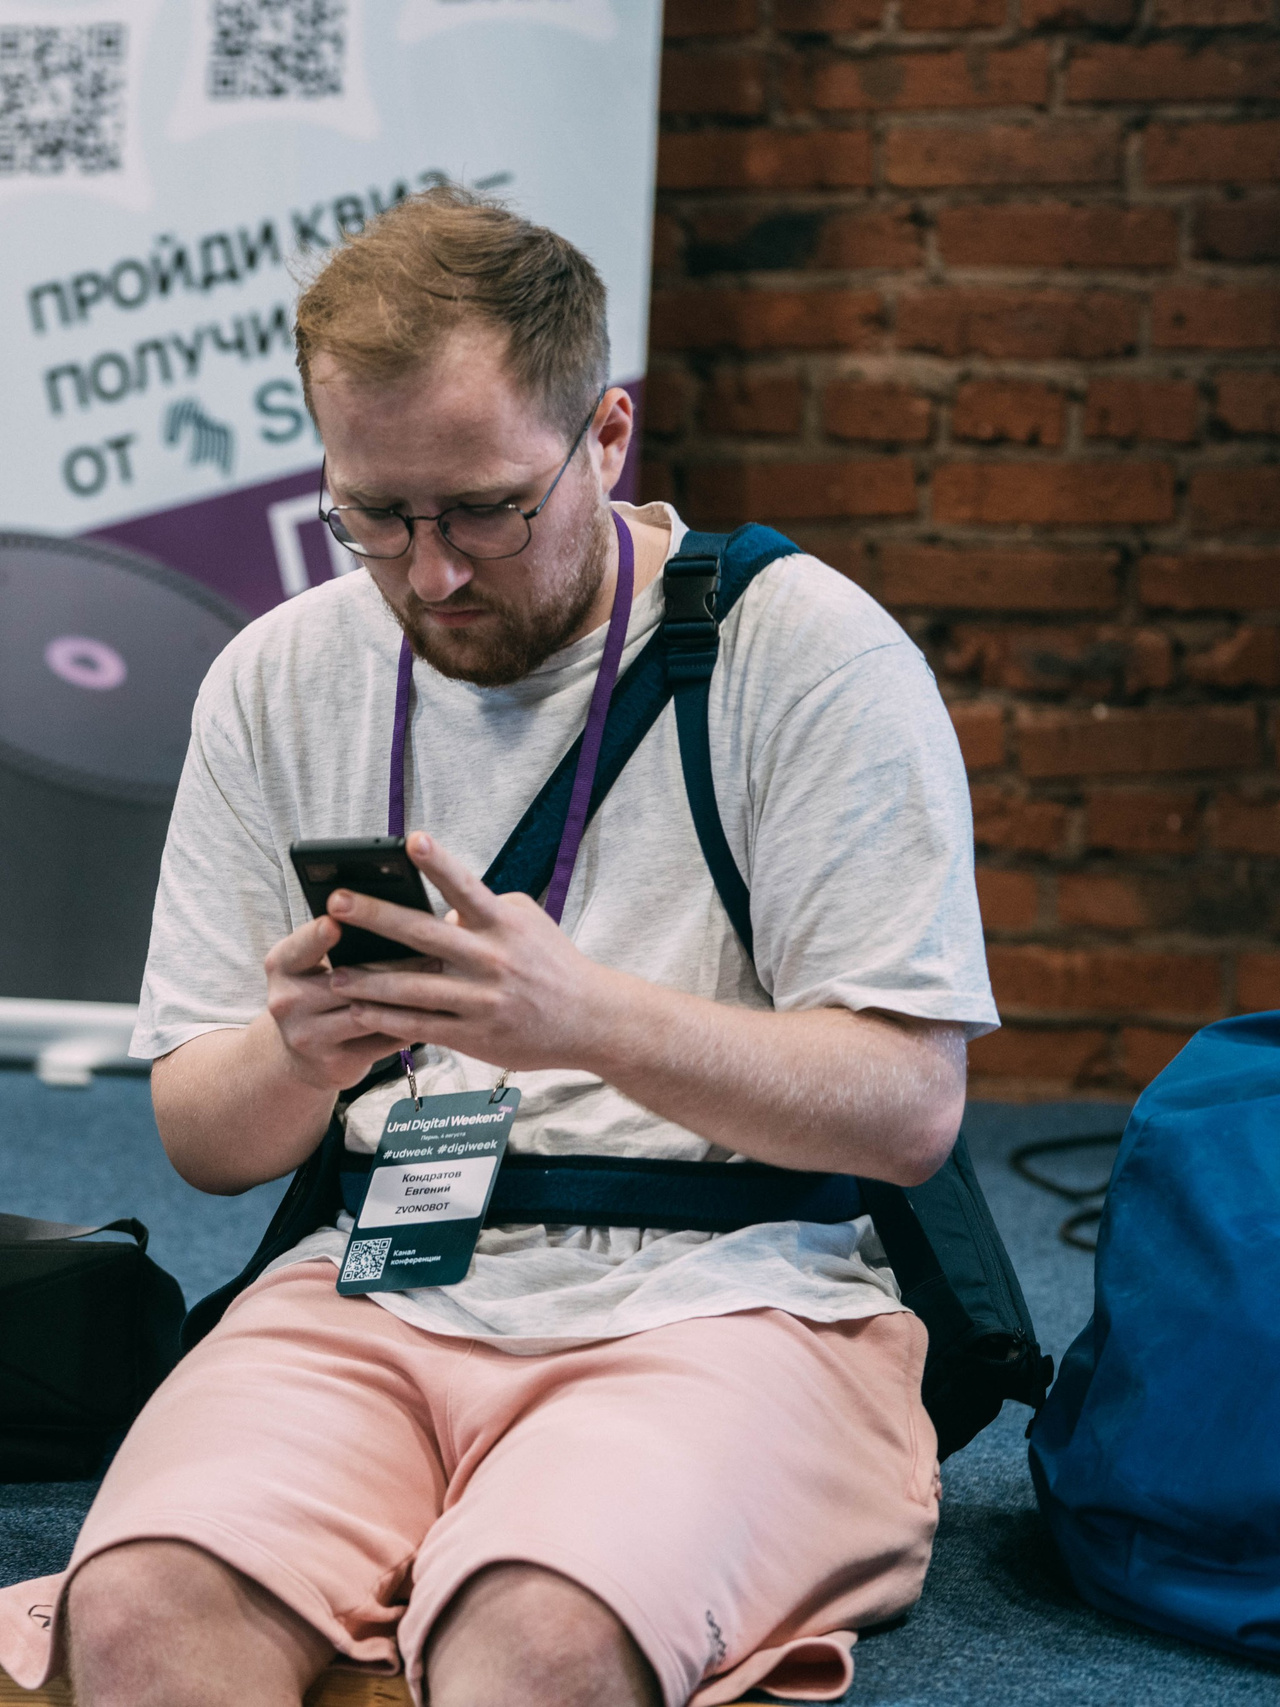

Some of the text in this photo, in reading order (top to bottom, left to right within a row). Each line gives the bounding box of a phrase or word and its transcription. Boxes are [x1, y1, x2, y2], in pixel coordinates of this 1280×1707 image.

[27, 214, 282, 336] ПРОЙДИ
[61, 431, 136, 497] ОТ
[387, 1111, 506, 1134] Ural Digital Weekend
[382, 1139, 498, 1160] #udweek #digiweek
[402, 1170, 462, 1183] Кондратов
[404, 1184, 451, 1196] Евгений
[395, 1202, 450, 1215] ZVONOBOT
[393, 1249, 416, 1257] Канал
[390, 1255, 441, 1266] конференции
